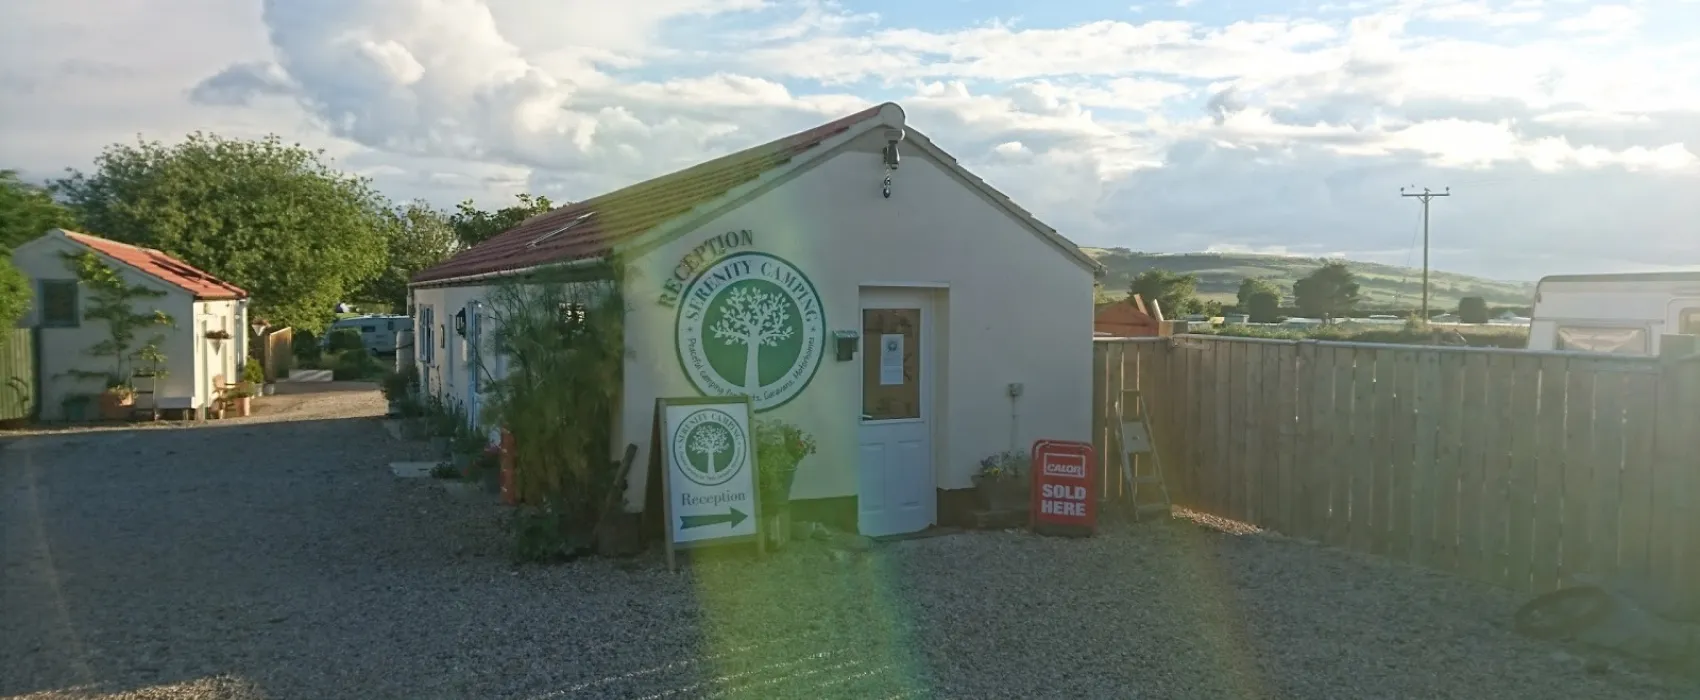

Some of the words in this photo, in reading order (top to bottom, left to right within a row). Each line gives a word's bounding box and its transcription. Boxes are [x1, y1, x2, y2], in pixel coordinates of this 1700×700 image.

[658, 229, 753, 309] RECEPTION
[686, 260, 752, 322] SERENITY
[760, 262, 818, 323] CAMPING
[688, 338, 702, 369] Peaceful
[678, 413, 708, 443] SERENITY
[711, 412, 741, 442] CAMPING
[1047, 463, 1083, 475] CALOR
[681, 490, 746, 507] Reception
[1042, 484, 1087, 500] SOLD
[1041, 499, 1086, 516] HERE
